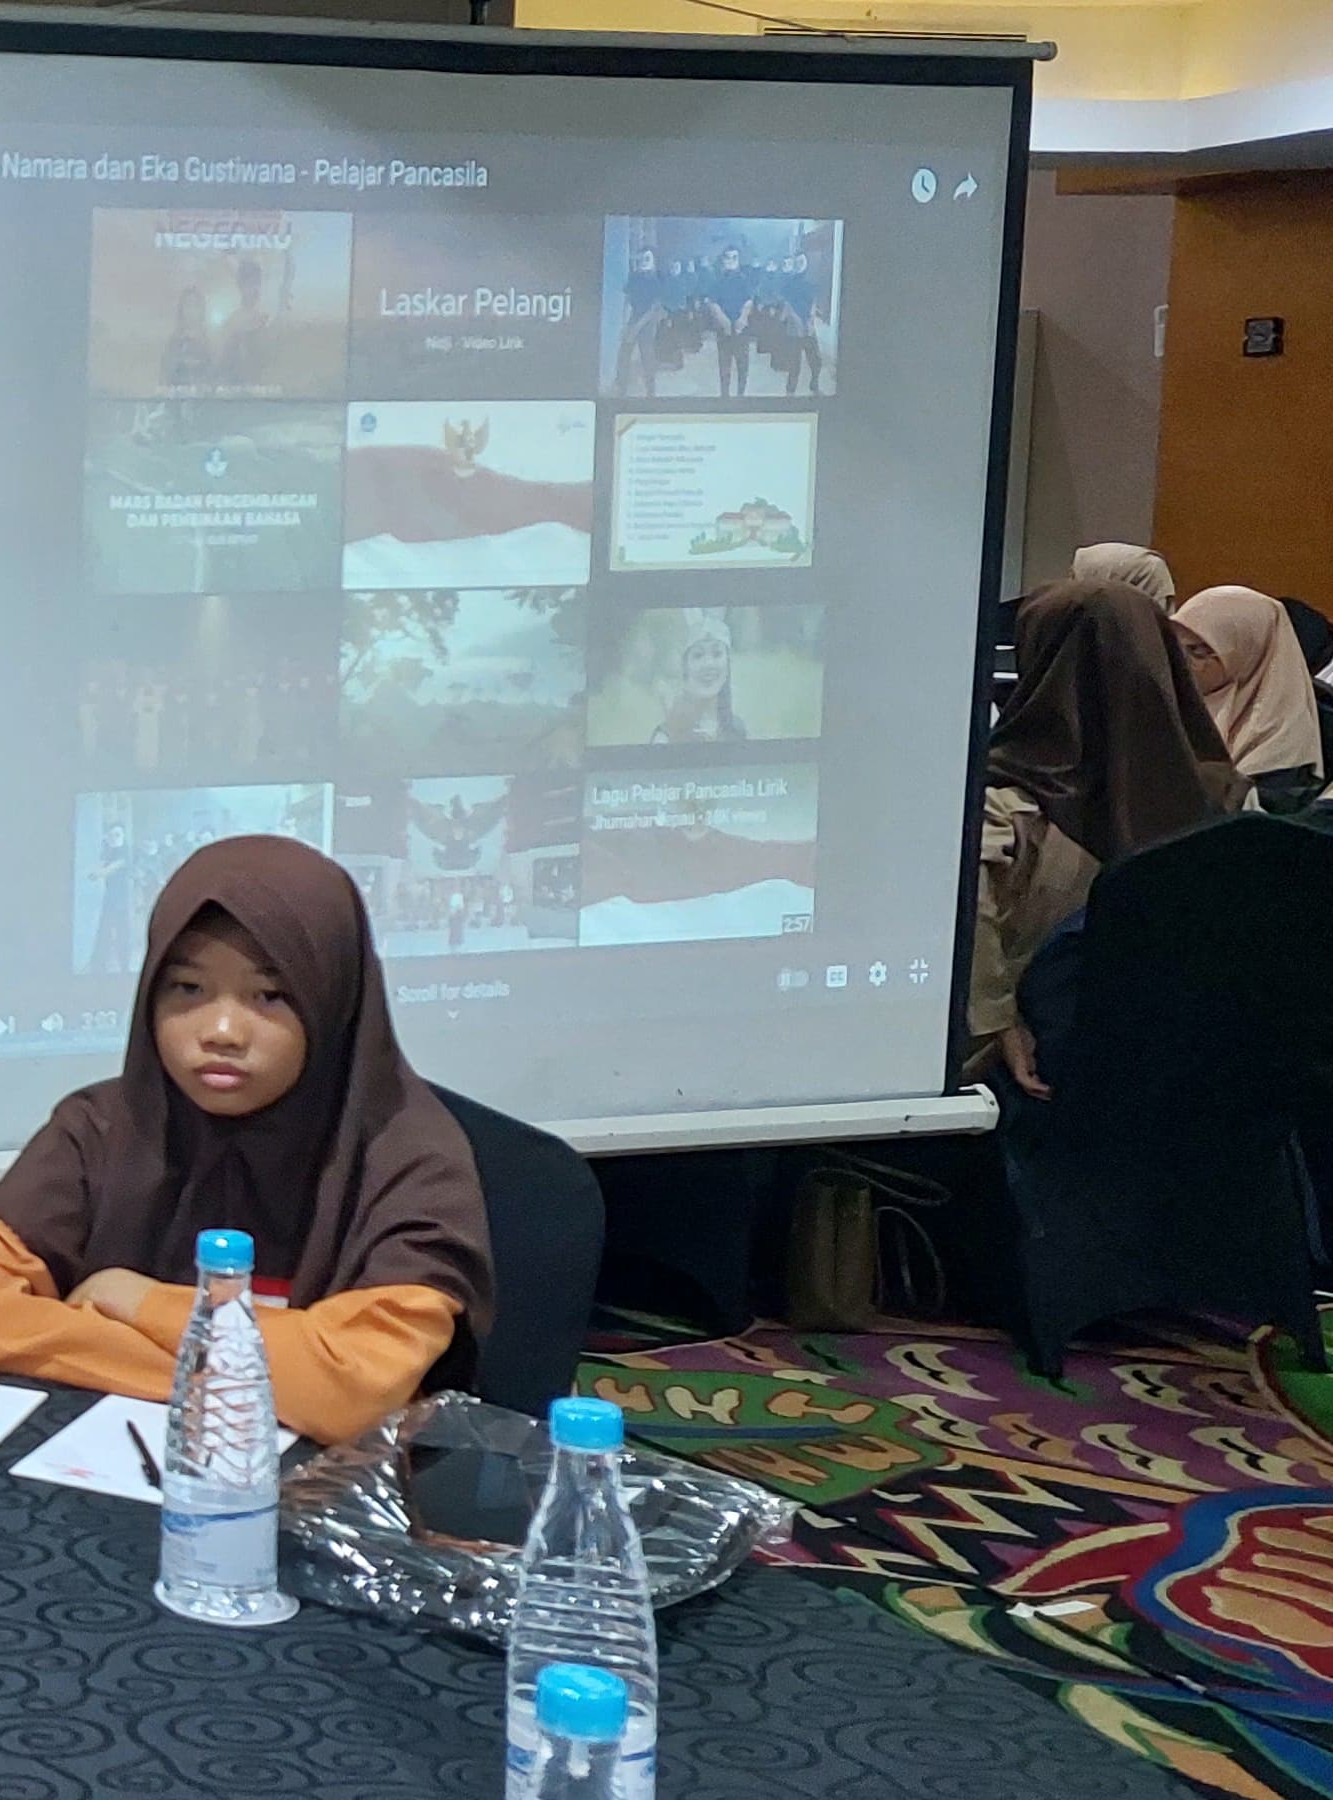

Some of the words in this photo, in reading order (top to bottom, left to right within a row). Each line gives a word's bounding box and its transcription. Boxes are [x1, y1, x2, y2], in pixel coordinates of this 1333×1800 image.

[1, 151, 88, 180] Namara
[93, 152, 135, 181] dan
[140, 154, 180, 182] Eka
[184, 155, 296, 184] Gustiwana
[314, 158, 386, 191] Pelajar
[390, 160, 489, 187] Pancasila
[380, 287, 468, 316] Laskar
[475, 287, 573, 322] Pelangi
[591, 786, 629, 808] Lagu
[632, 783, 683, 804] Pelajar
[685, 780, 755, 801] Pancasila
[782, 916, 812, 933] 2:57
